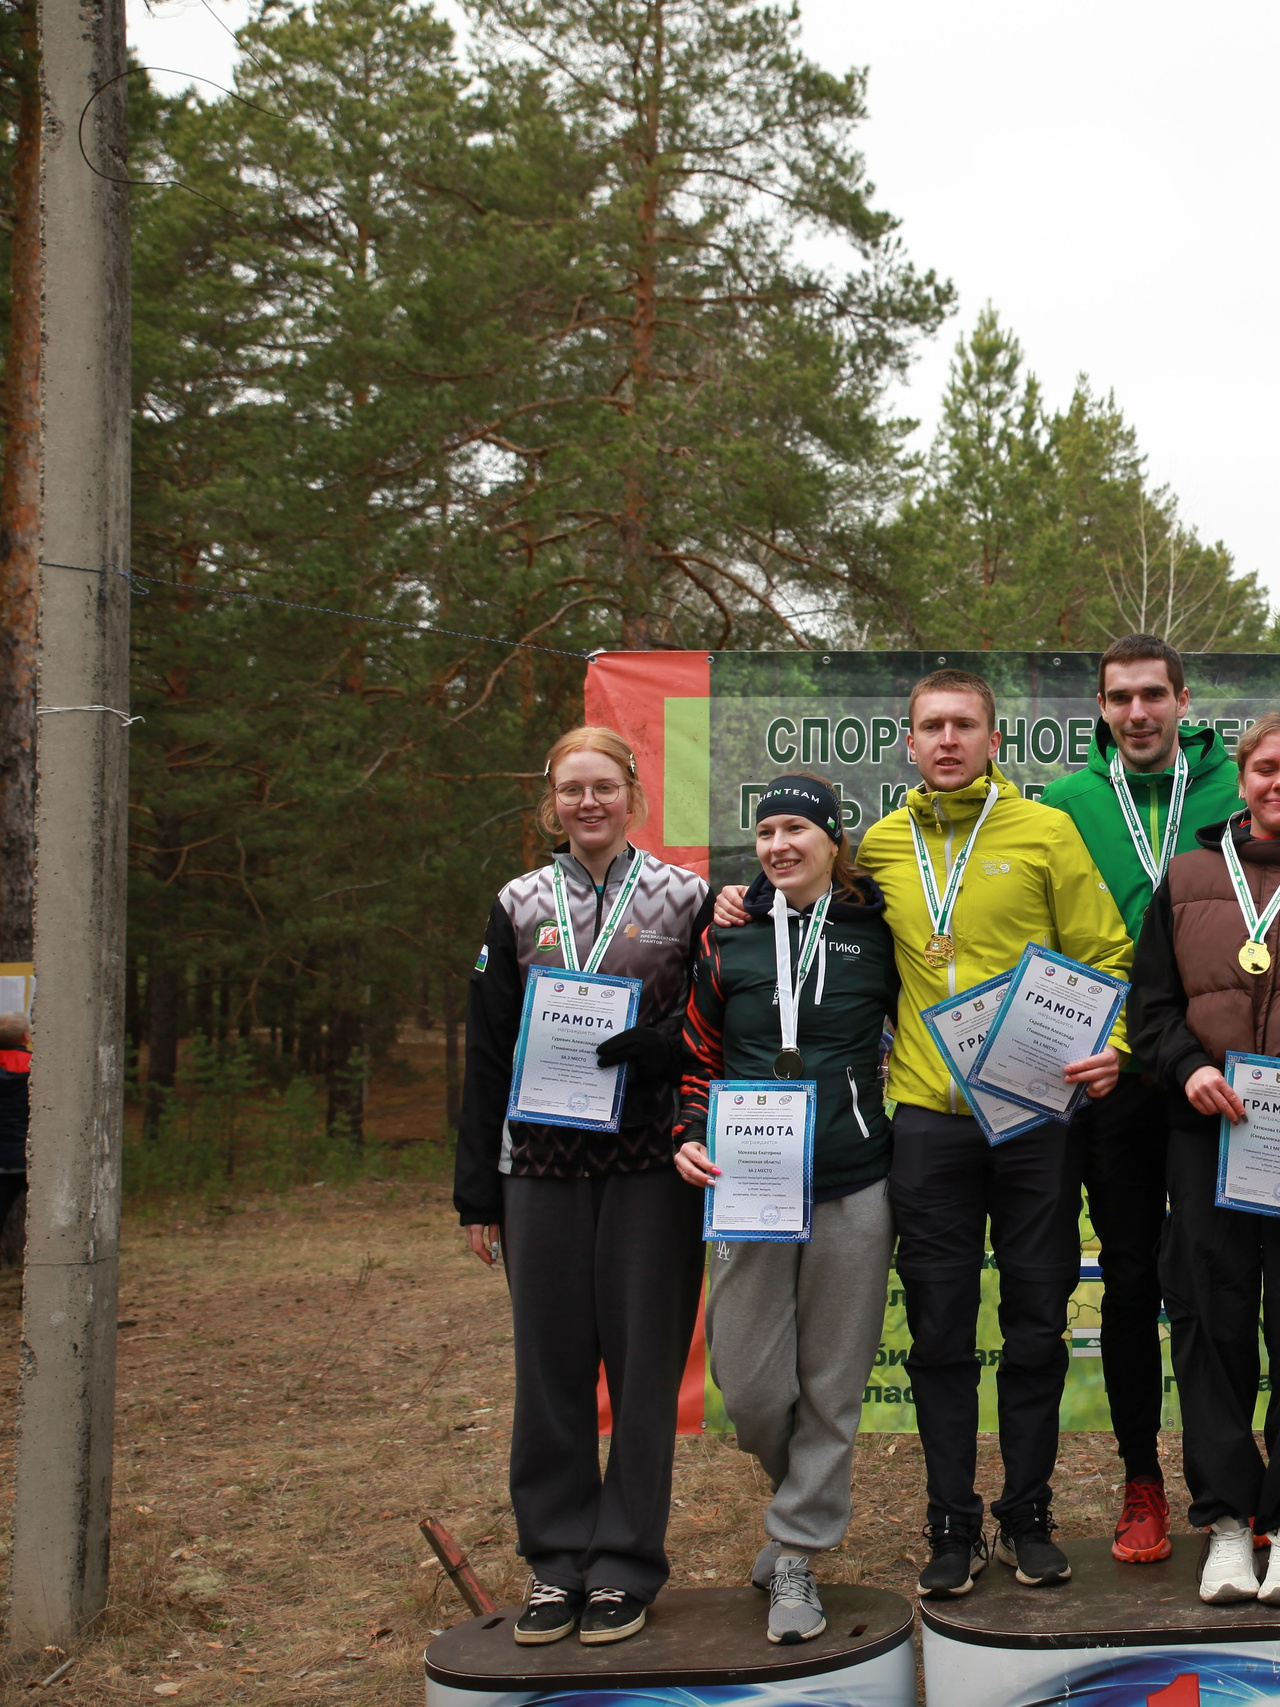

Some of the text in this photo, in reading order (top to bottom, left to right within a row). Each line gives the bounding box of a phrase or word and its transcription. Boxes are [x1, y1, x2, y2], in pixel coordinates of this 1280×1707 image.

[829, 941, 861, 955] ГИКО
[1025, 991, 1093, 1028] ГРАМОТА
[542, 1010, 614, 1030] ГРАМОТА
[725, 1125, 794, 1136] ГРАМОТА
